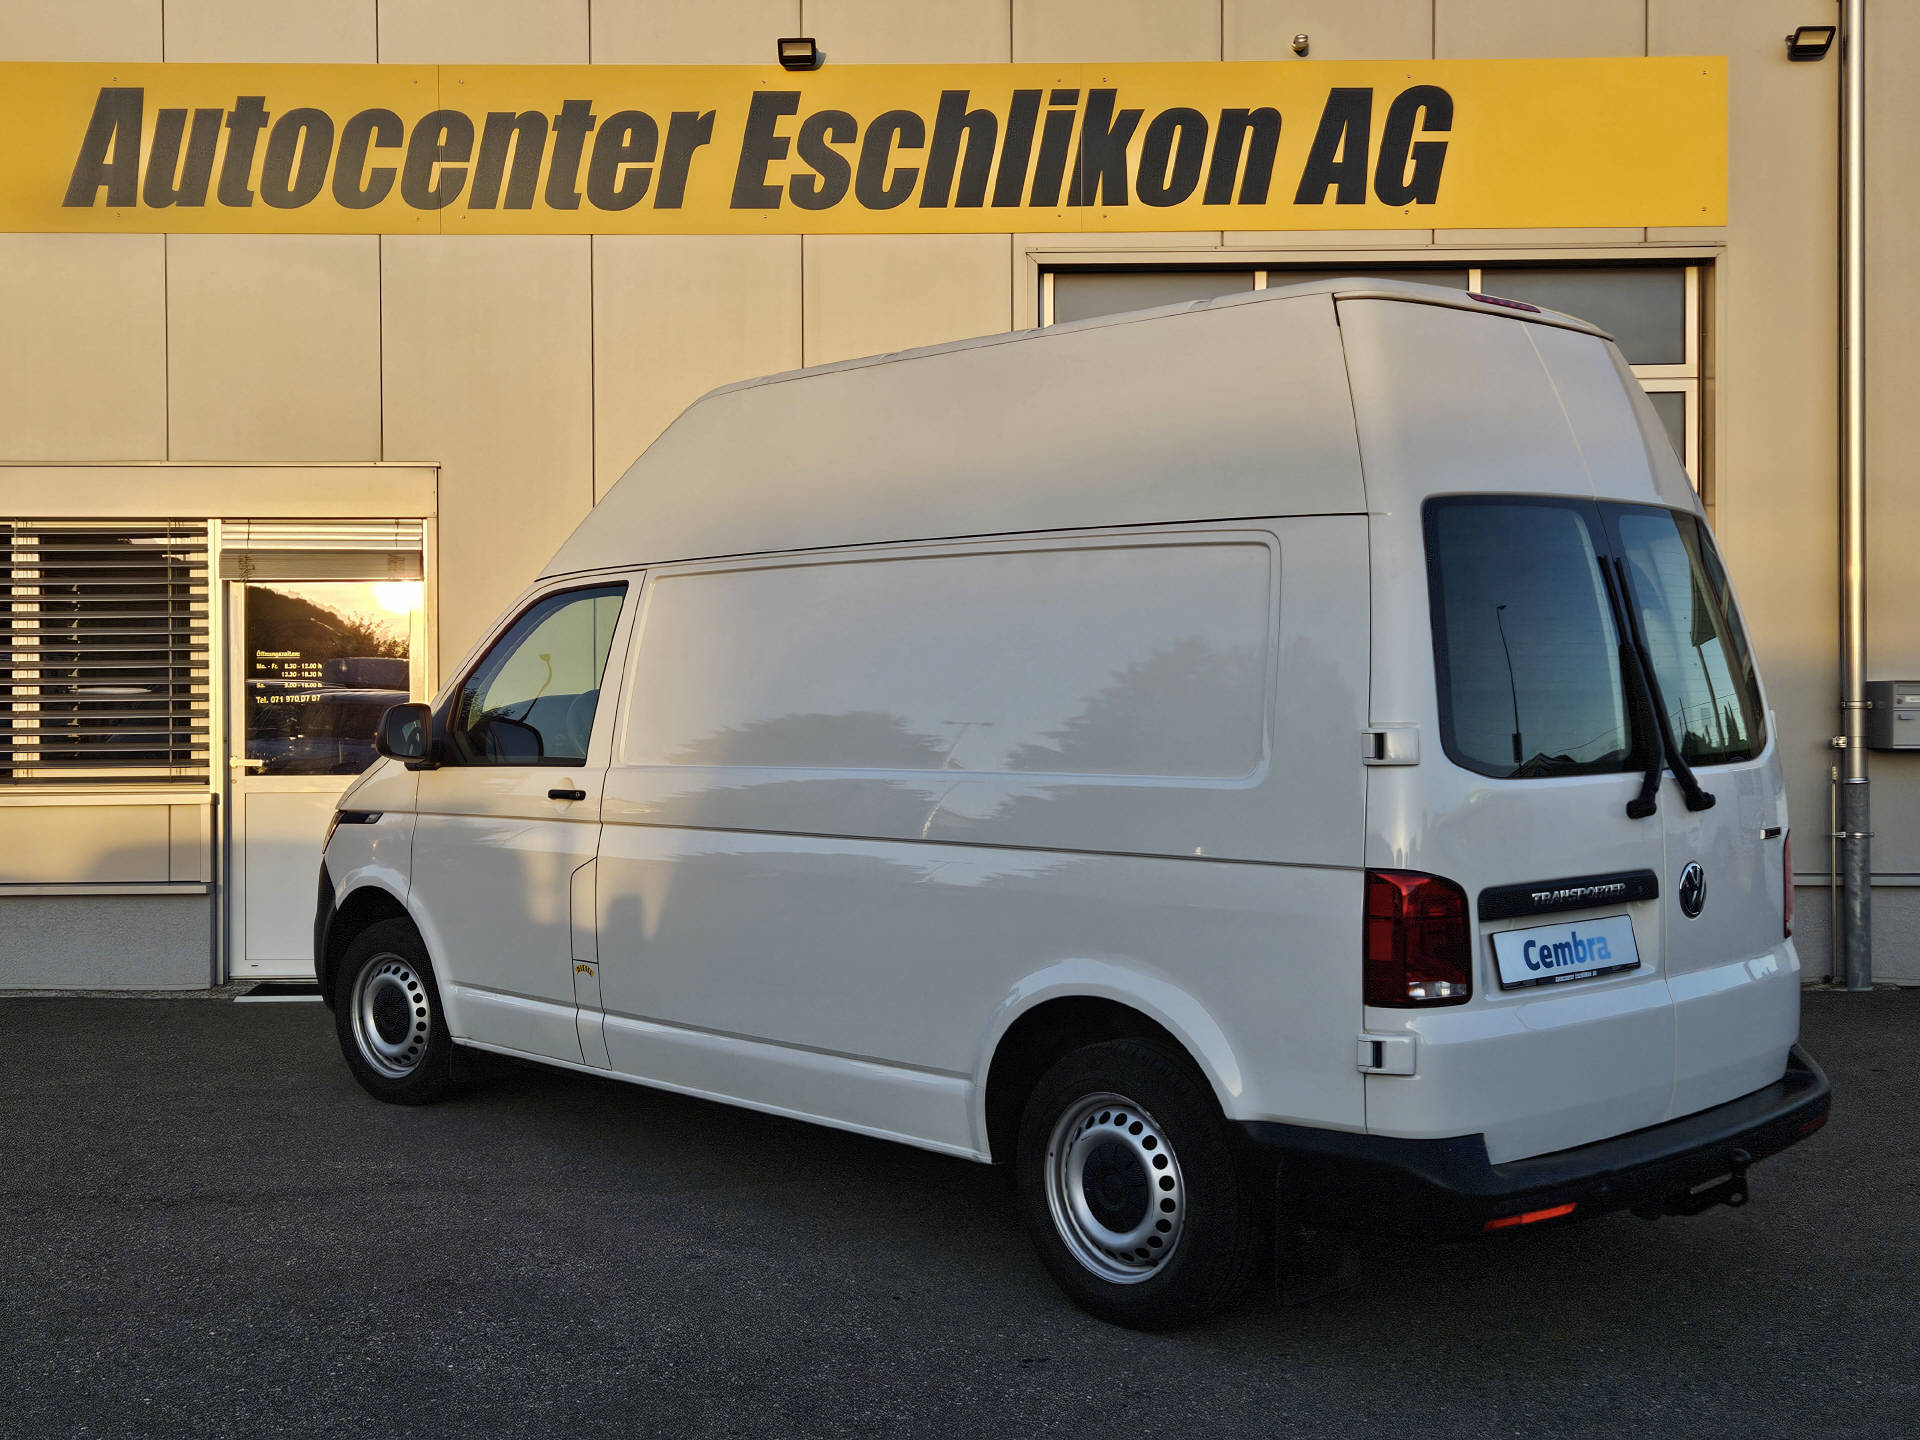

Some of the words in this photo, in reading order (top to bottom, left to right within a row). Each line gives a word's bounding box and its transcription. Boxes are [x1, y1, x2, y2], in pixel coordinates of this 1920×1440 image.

[62, 87, 716, 211] Autocenter
[730, 89, 1284, 210] Eschlikon
[1294, 85, 1454, 207] AG
[270, 695, 284, 703] 071
[285, 695, 300, 703] 970
[311, 694, 321, 702] 07
[1531, 882, 1626, 904] TRANSPORTER
[1522, 930, 1612, 972] Cembra
